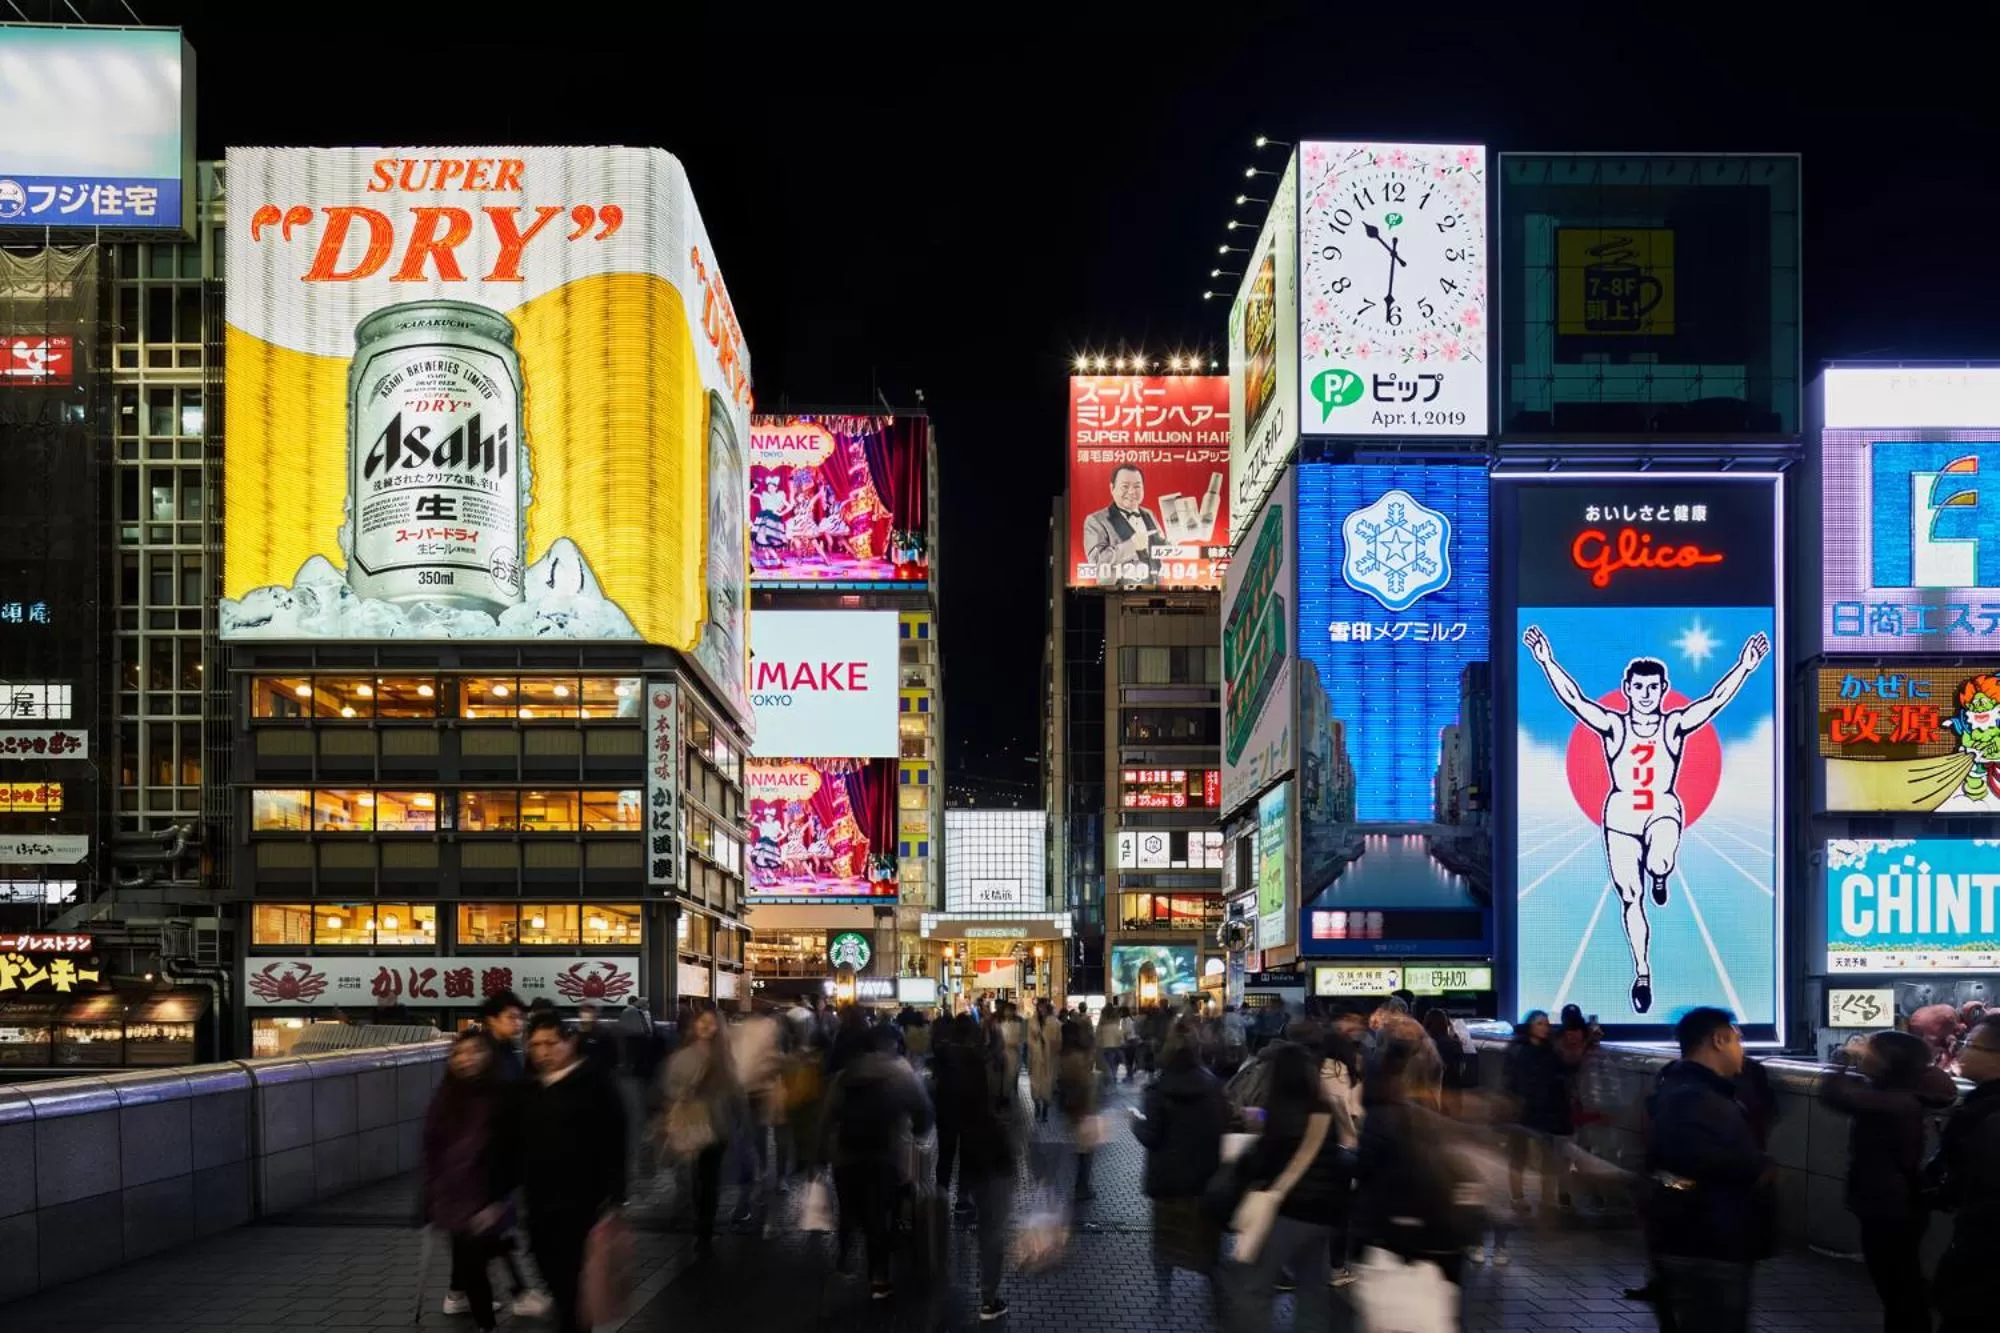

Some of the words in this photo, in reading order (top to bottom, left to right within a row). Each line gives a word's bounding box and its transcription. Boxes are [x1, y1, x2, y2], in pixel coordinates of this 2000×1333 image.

[366, 158, 526, 193] SUPER
[27, 183, 158, 216] フジ住宅
[1353, 187, 1376, 211] 11
[1381, 182, 1405, 203] 12
[1418, 192, 1432, 210] 1
[1328, 208, 1353, 235] 10
[1436, 214, 1457, 233] 2
[1321, 245, 1343, 261] 9
[1444, 247, 1466, 263] 3
[1330, 276, 1352, 294] 8
[1438, 276, 1458, 295] 4
[1356, 297, 1377, 316] 7
[1387, 304, 1403, 327] 6
[1416, 296, 1434, 319] 5
[379, 372, 405, 399] ASAHI
[406, 359, 461, 378] BREWERIES
[462, 368, 494, 401] LIMITED
[1372, 372, 1445, 403] ピップ
[1077, 380, 1166, 404] スーパー
[1077, 405, 1230, 427] ミリオンヘアー
[1371, 410, 1407, 428] Apr.
[1425, 411, 1467, 426] 2019
[363, 411, 509, 482] Asahi
[751, 434, 821, 451] NMAKE
[1077, 431, 1130, 444] SUPER
[1134, 431, 1193, 444] MILLION
[760, 451, 784, 459] TOKYO
[415, 493, 458, 521] 生
[1585, 504, 1709, 523] おいしさと健康
[395, 527, 480, 543] スーパードライ
[1571, 527, 1724, 589] Glico
[417, 570, 455, 586] 350ml
[1833, 601, 2000, 637] 日商エステ
[1328, 621, 1468, 642] 雪印メグミルク
[1839, 673, 1933, 699] かぜに
[1828, 702, 1941, 745] 改源
[653, 714, 671, 781] 本場の味
[1630, 740, 1657, 811] グリコ
